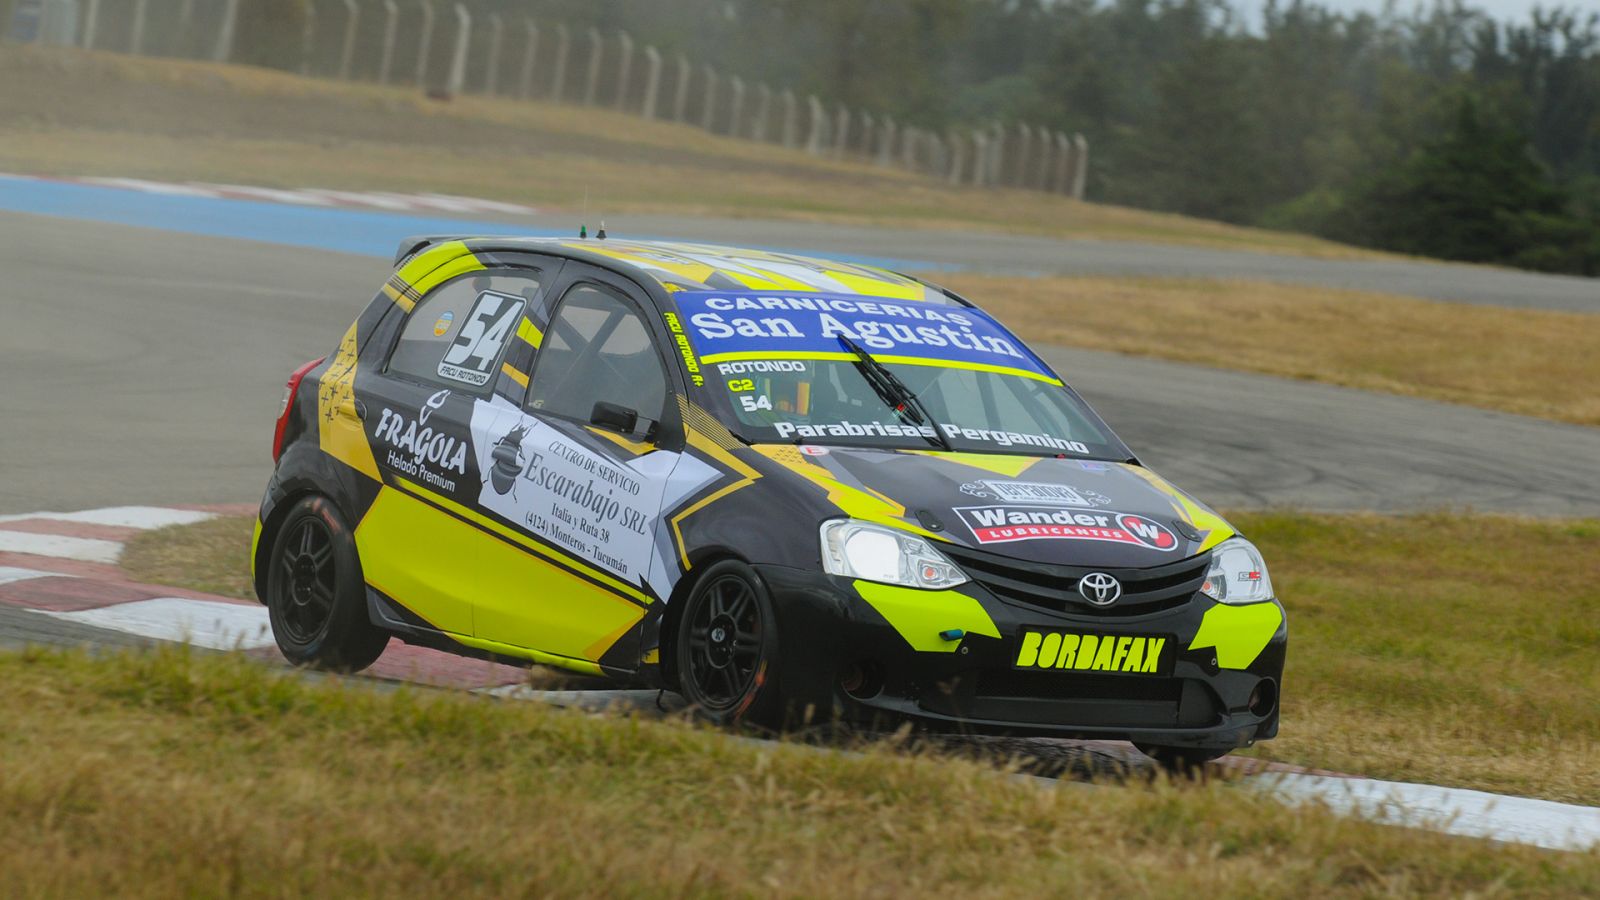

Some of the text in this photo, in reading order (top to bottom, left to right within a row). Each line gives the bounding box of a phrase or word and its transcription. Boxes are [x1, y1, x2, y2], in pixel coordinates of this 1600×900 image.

[705, 297, 973, 327] CARNICERIAS
[444, 294, 524, 371] 54
[690, 312, 1024, 359] San Agustin
[674, 334, 700, 373] ROTONDO
[717, 360, 806, 375] ROTONDO
[458, 370, 487, 384] ROTONDO
[727, 379, 755, 392] C2
[739, 395, 772, 412] 54
[374, 407, 467, 475] FRAGOLA
[774, 419, 1090, 454] Parabrisas Pergamino
[387, 449, 456, 492] Helado Premium
[548, 440, 641, 496] CENTRO DE SERVICIO
[522, 452, 649, 536] Escarabajo SRL
[525, 510, 549, 536] (4124)
[549, 523, 587, 553] Monteros
[592, 544, 628, 574] Tucumán
[551, 503, 611, 544] Italia y Ruta 38
[970, 508, 1161, 540] Wander W
[990, 528, 1123, 539] LUBRICANTES
[1016, 631, 1166, 673] BORDAFAX
